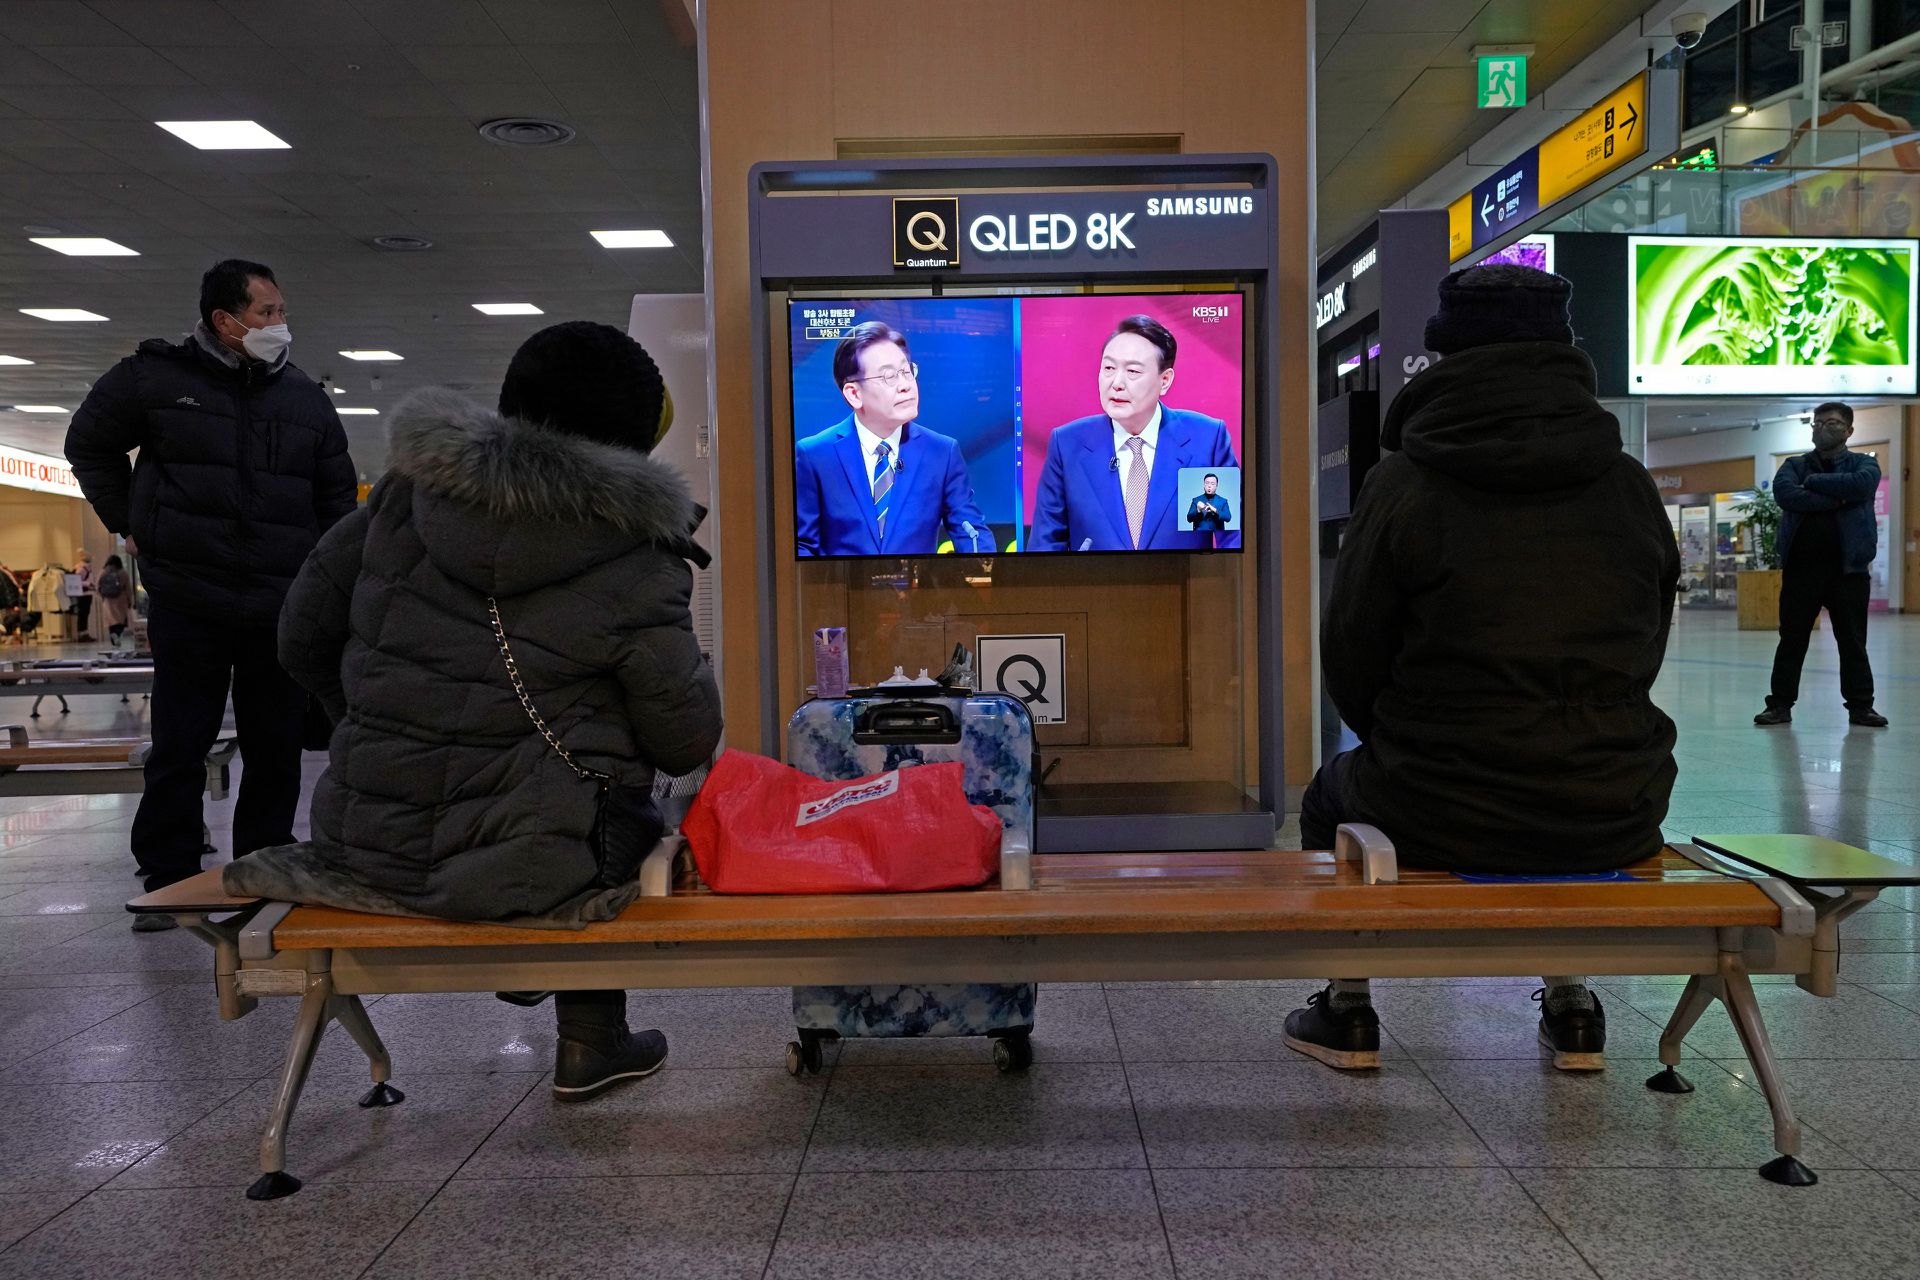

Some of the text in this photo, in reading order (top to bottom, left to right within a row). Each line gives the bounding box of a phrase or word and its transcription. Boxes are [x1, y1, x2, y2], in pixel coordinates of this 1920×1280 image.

[1147, 197, 1253, 216] SAMSUNG
[906, 211, 949, 251] Q
[969, 212, 1136, 251] QLED 8K
[906, 258, 947, 268] Quantum
[1352, 248, 1376, 279] SAMSUNG
[1334, 281, 1345, 317] 8K
[820, 328, 840, 338] 부동산
[1, 456, 77, 487] LOTTE OUTLETS
[997, 653, 1050, 704] Q
